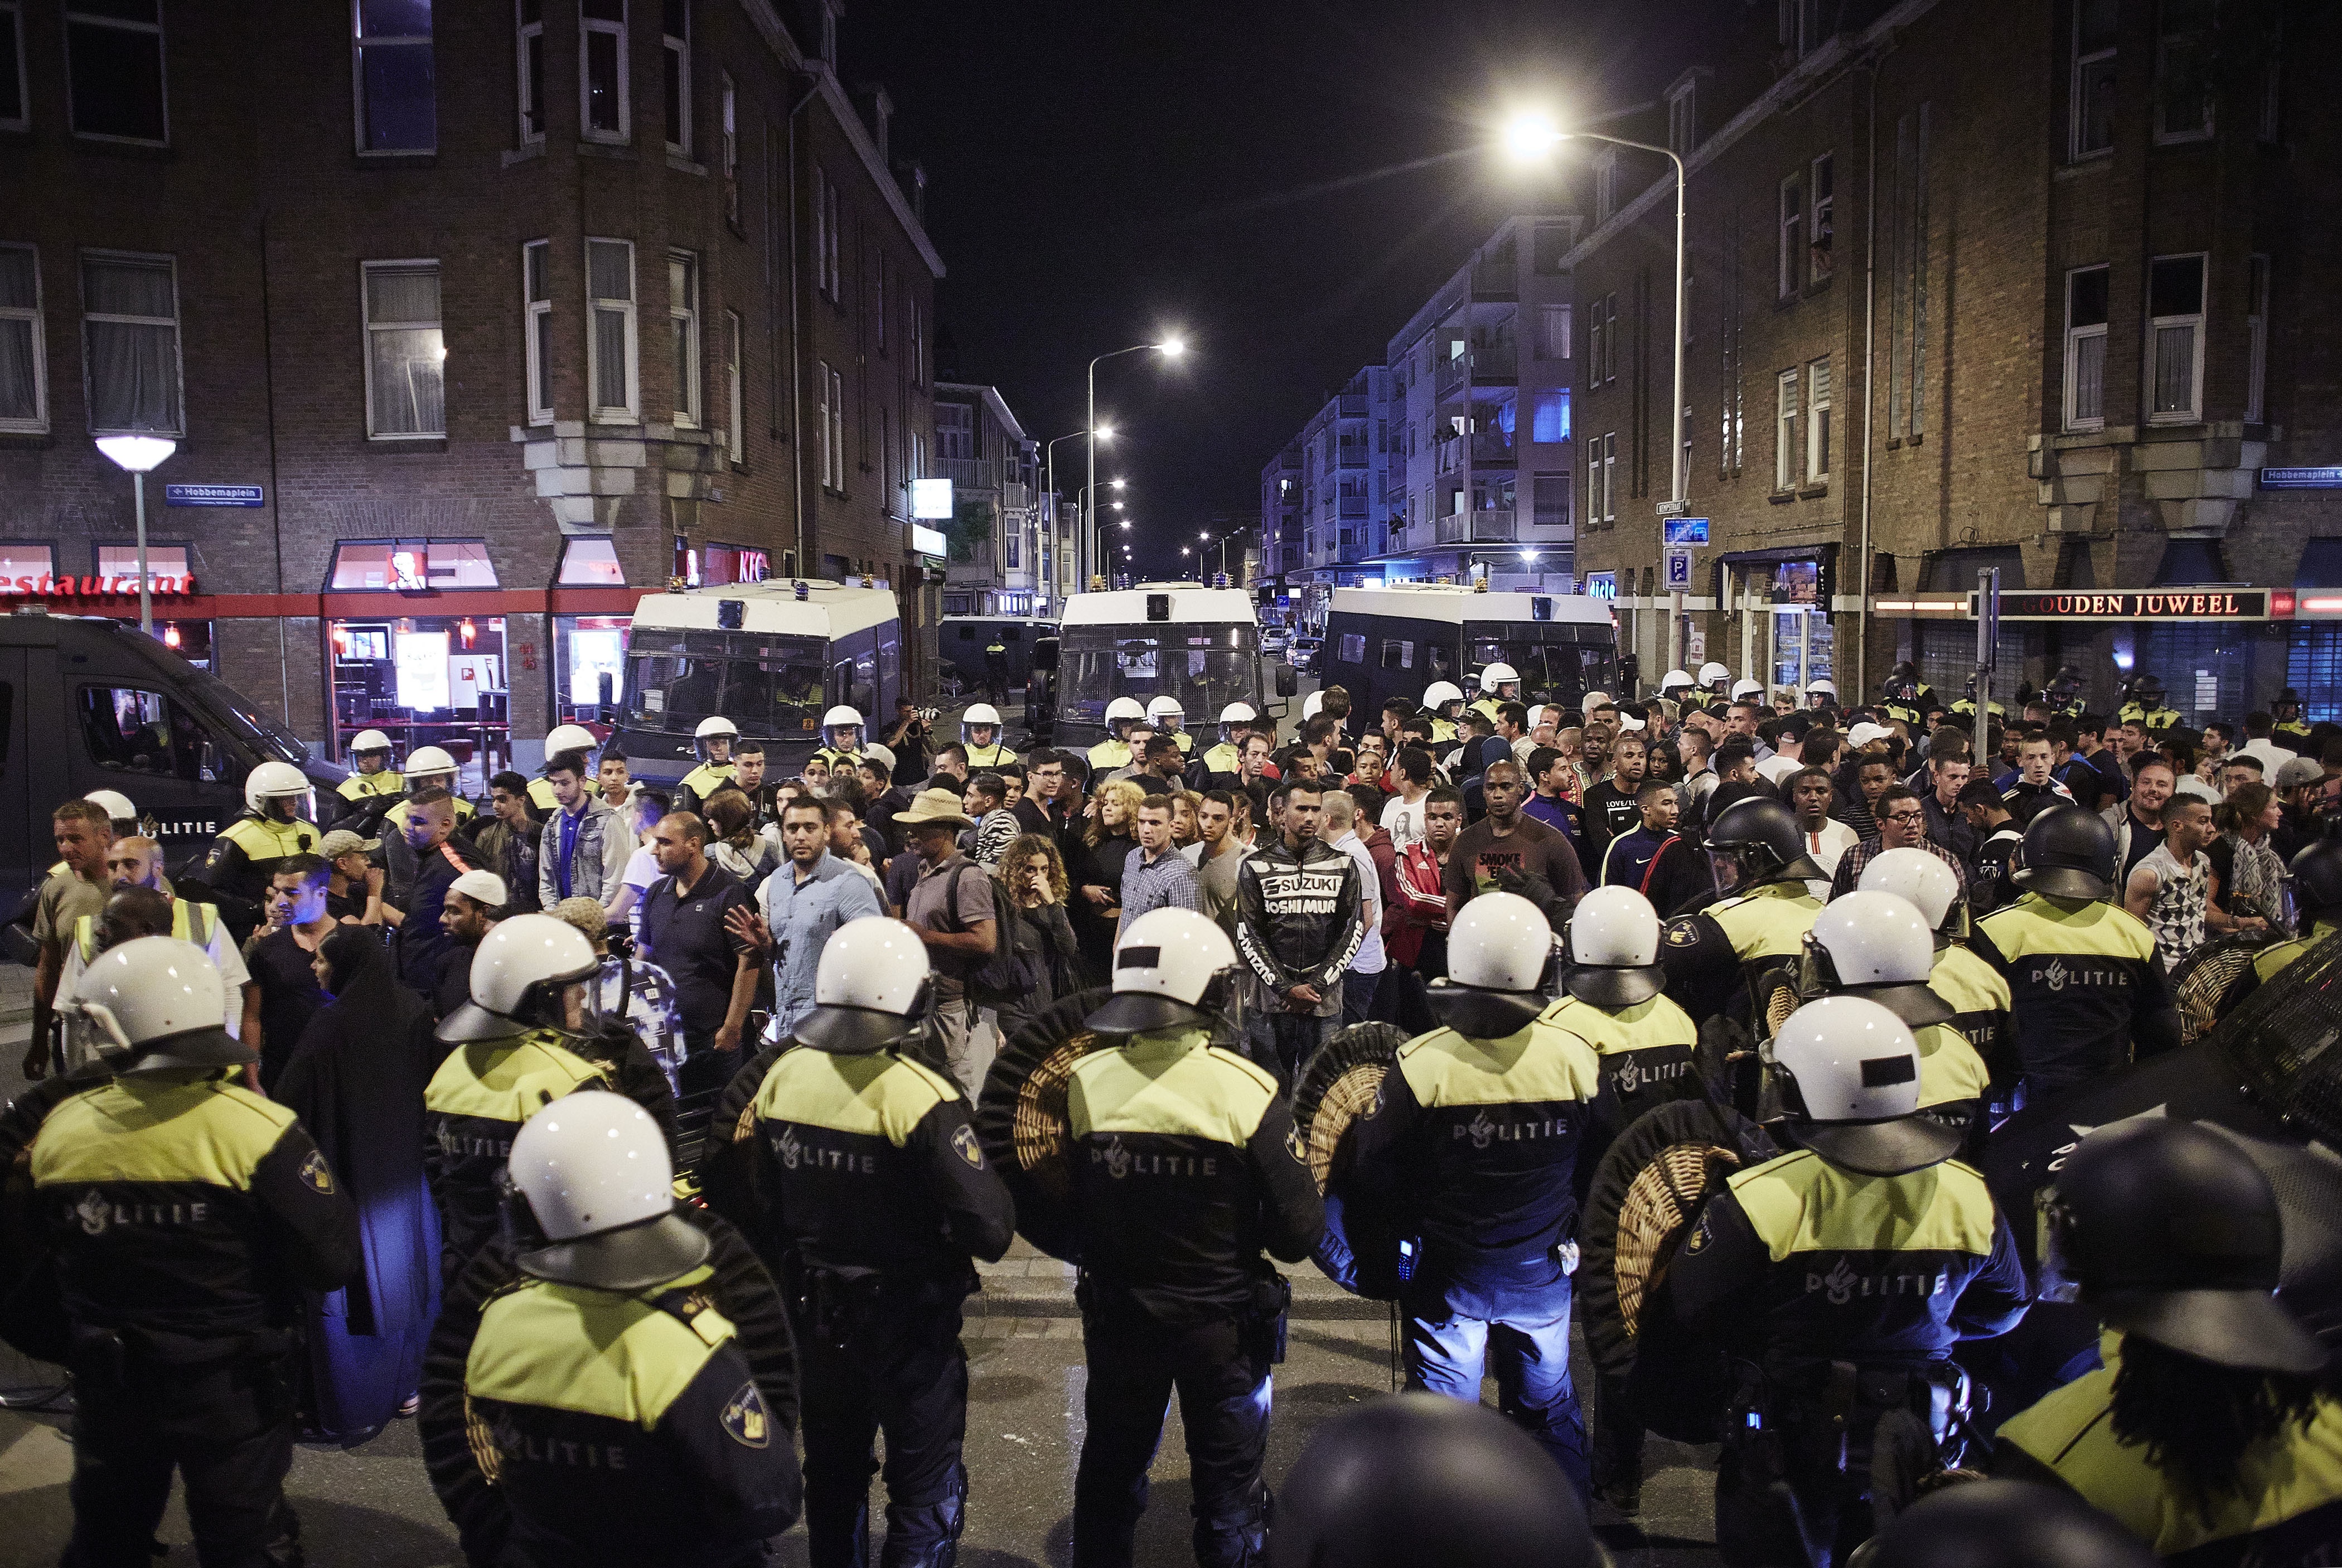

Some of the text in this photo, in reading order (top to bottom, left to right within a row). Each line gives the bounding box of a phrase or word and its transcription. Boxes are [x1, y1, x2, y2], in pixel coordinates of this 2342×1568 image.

[2268, 471, 2335, 480] Hobbemaplein
[185, 487, 255, 497] Hobbemaplein
[1675, 562, 1683, 573] P
[0, 571, 193, 596] estaurant
[1590, 580, 1615, 600] dicle
[2133, 595, 2239, 616] JUWEEL
[142, 822, 216, 839] OLITIE
[1282, 878, 1337, 892] SUZUKI
[1265, 899, 1337, 914] OSHIMUR
[1336, 919, 1364, 973] SUZUKI
[1241, 937, 1276, 986] SUZUKI
